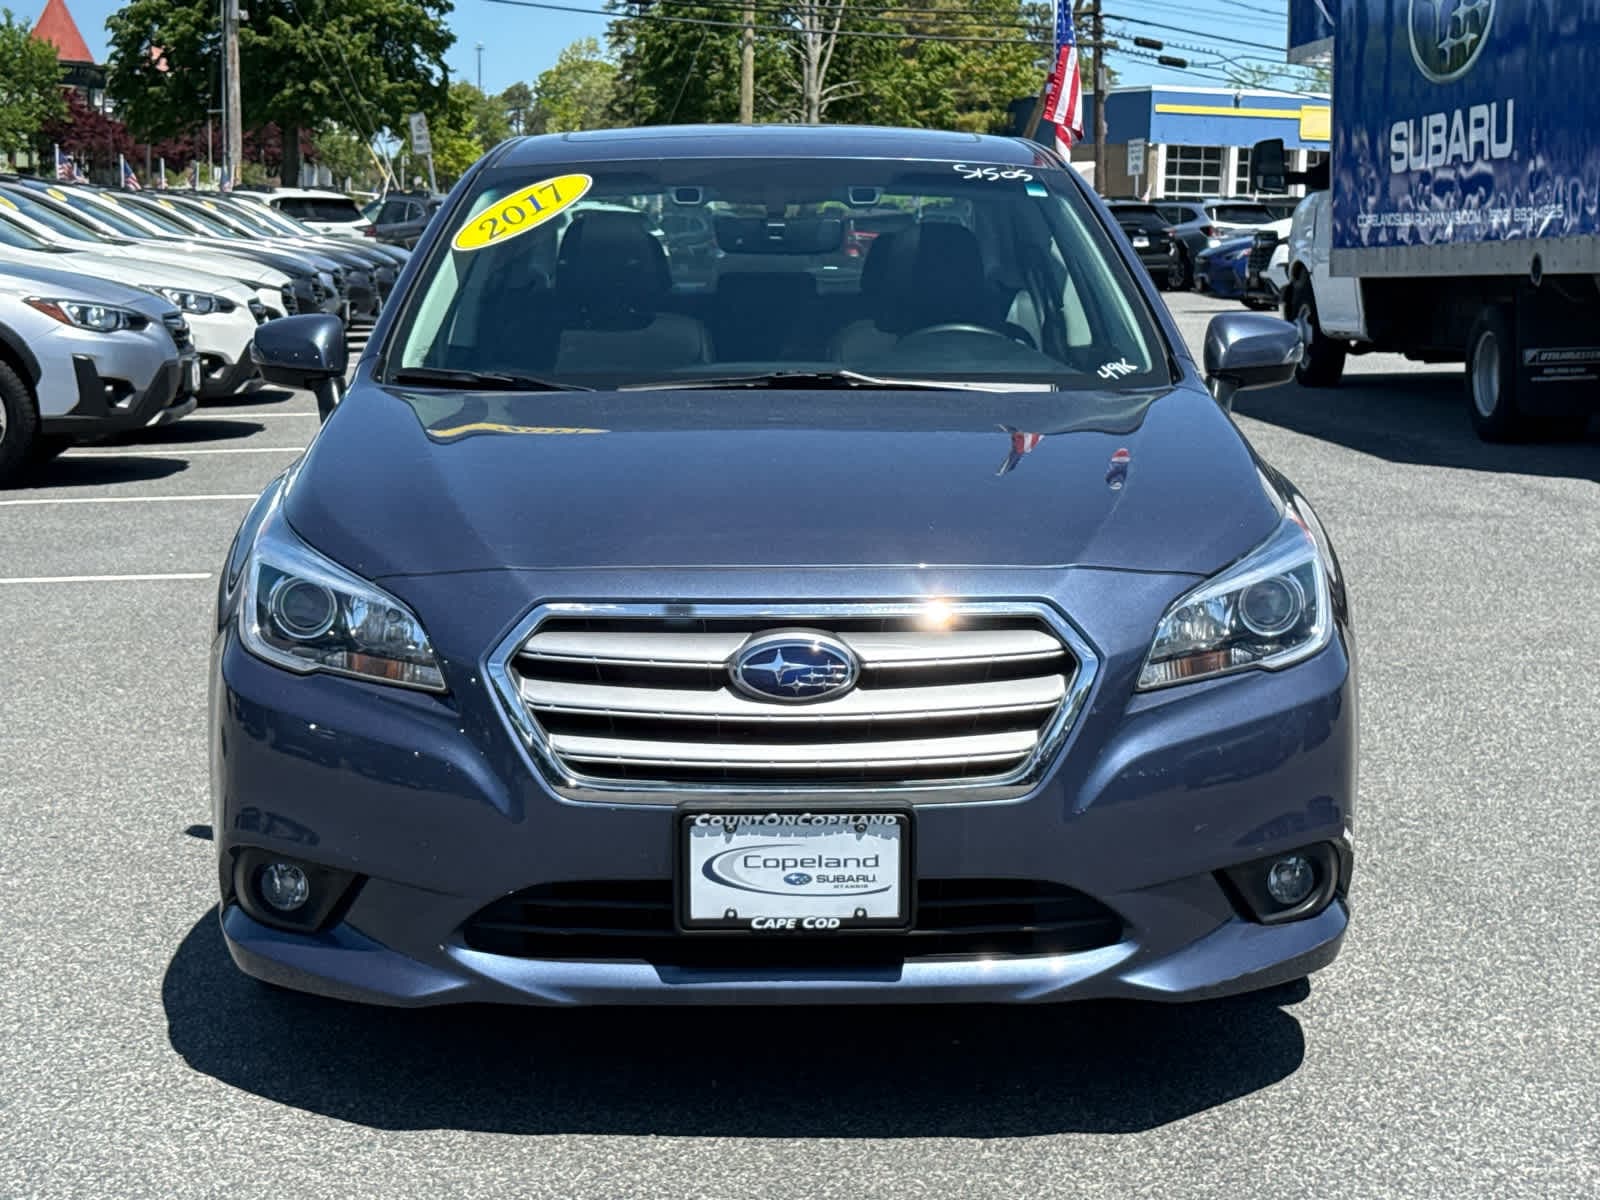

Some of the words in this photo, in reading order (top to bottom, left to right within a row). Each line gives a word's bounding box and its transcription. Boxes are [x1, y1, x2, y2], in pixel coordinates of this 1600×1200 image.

[1390, 99, 1514, 173] SUBARU
[479, 183, 563, 240] 2017
[1097, 358, 1138, 379] 49K
[743, 854, 880, 871] Copeland
[815, 873, 877, 884] SUBARU
[751, 916, 797, 930] CAPE
[802, 916, 841, 930] COD
